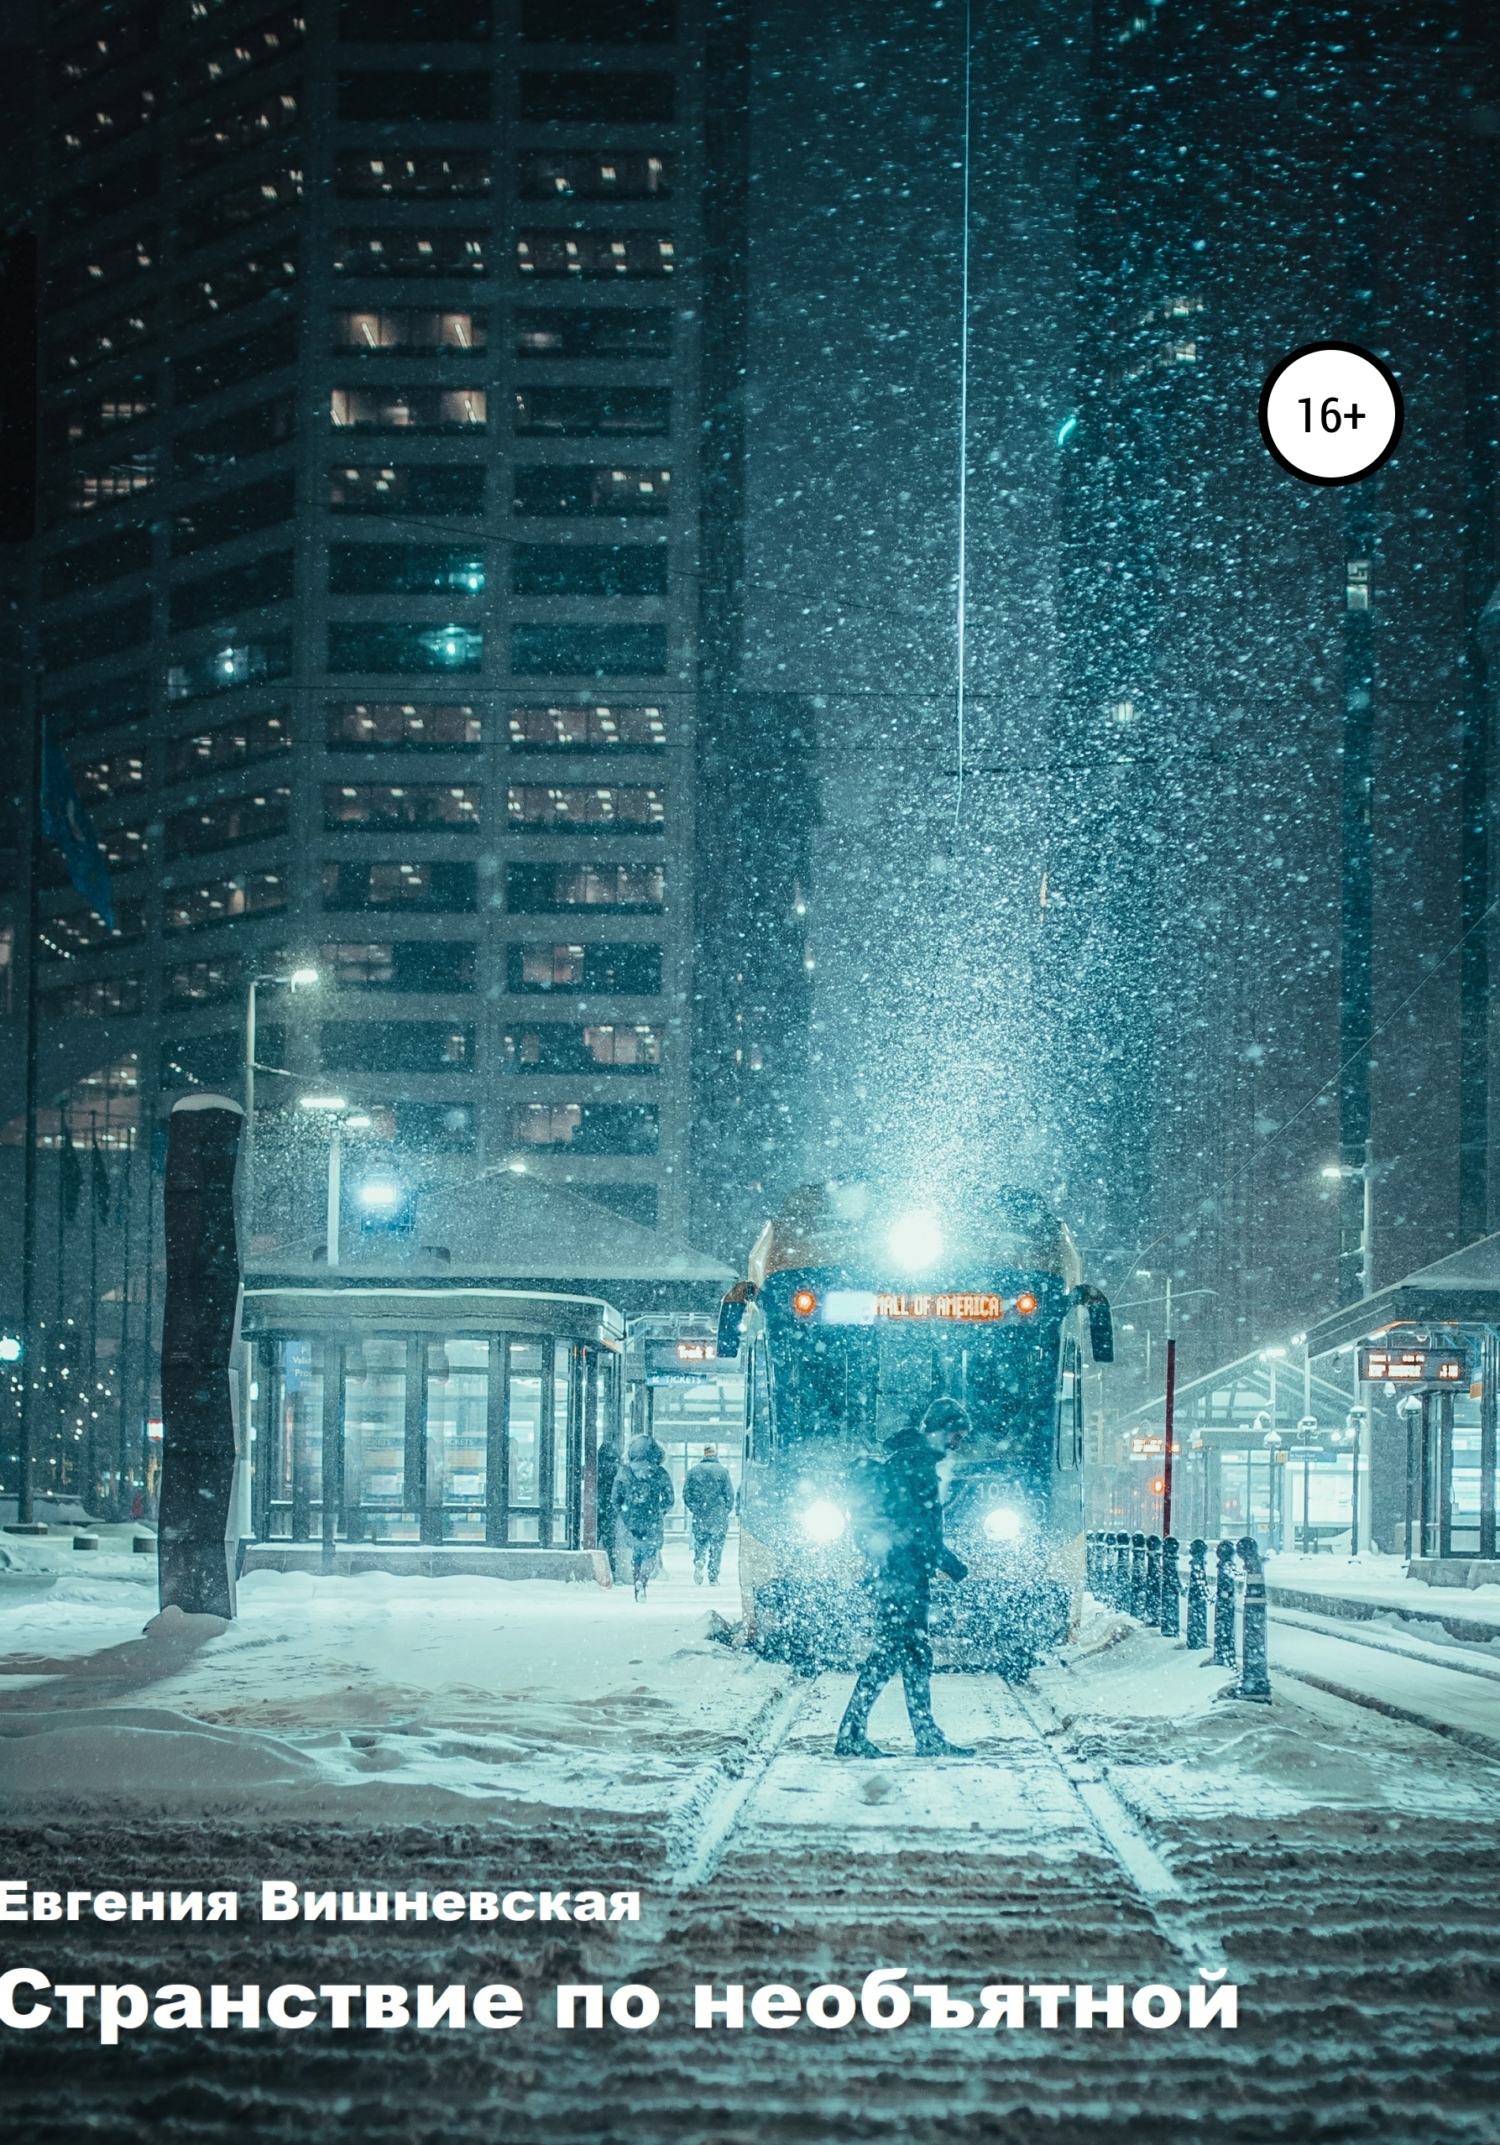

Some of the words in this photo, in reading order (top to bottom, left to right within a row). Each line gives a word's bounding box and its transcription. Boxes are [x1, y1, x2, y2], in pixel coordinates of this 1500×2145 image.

[876, 1296, 909, 1316] MALL
[914, 1296, 931, 1316] OF
[936, 1296, 999, 1317] AMERICA
[665, 1376, 702, 1384] TICKETS
[976, 1482, 1025, 1501] 107A
